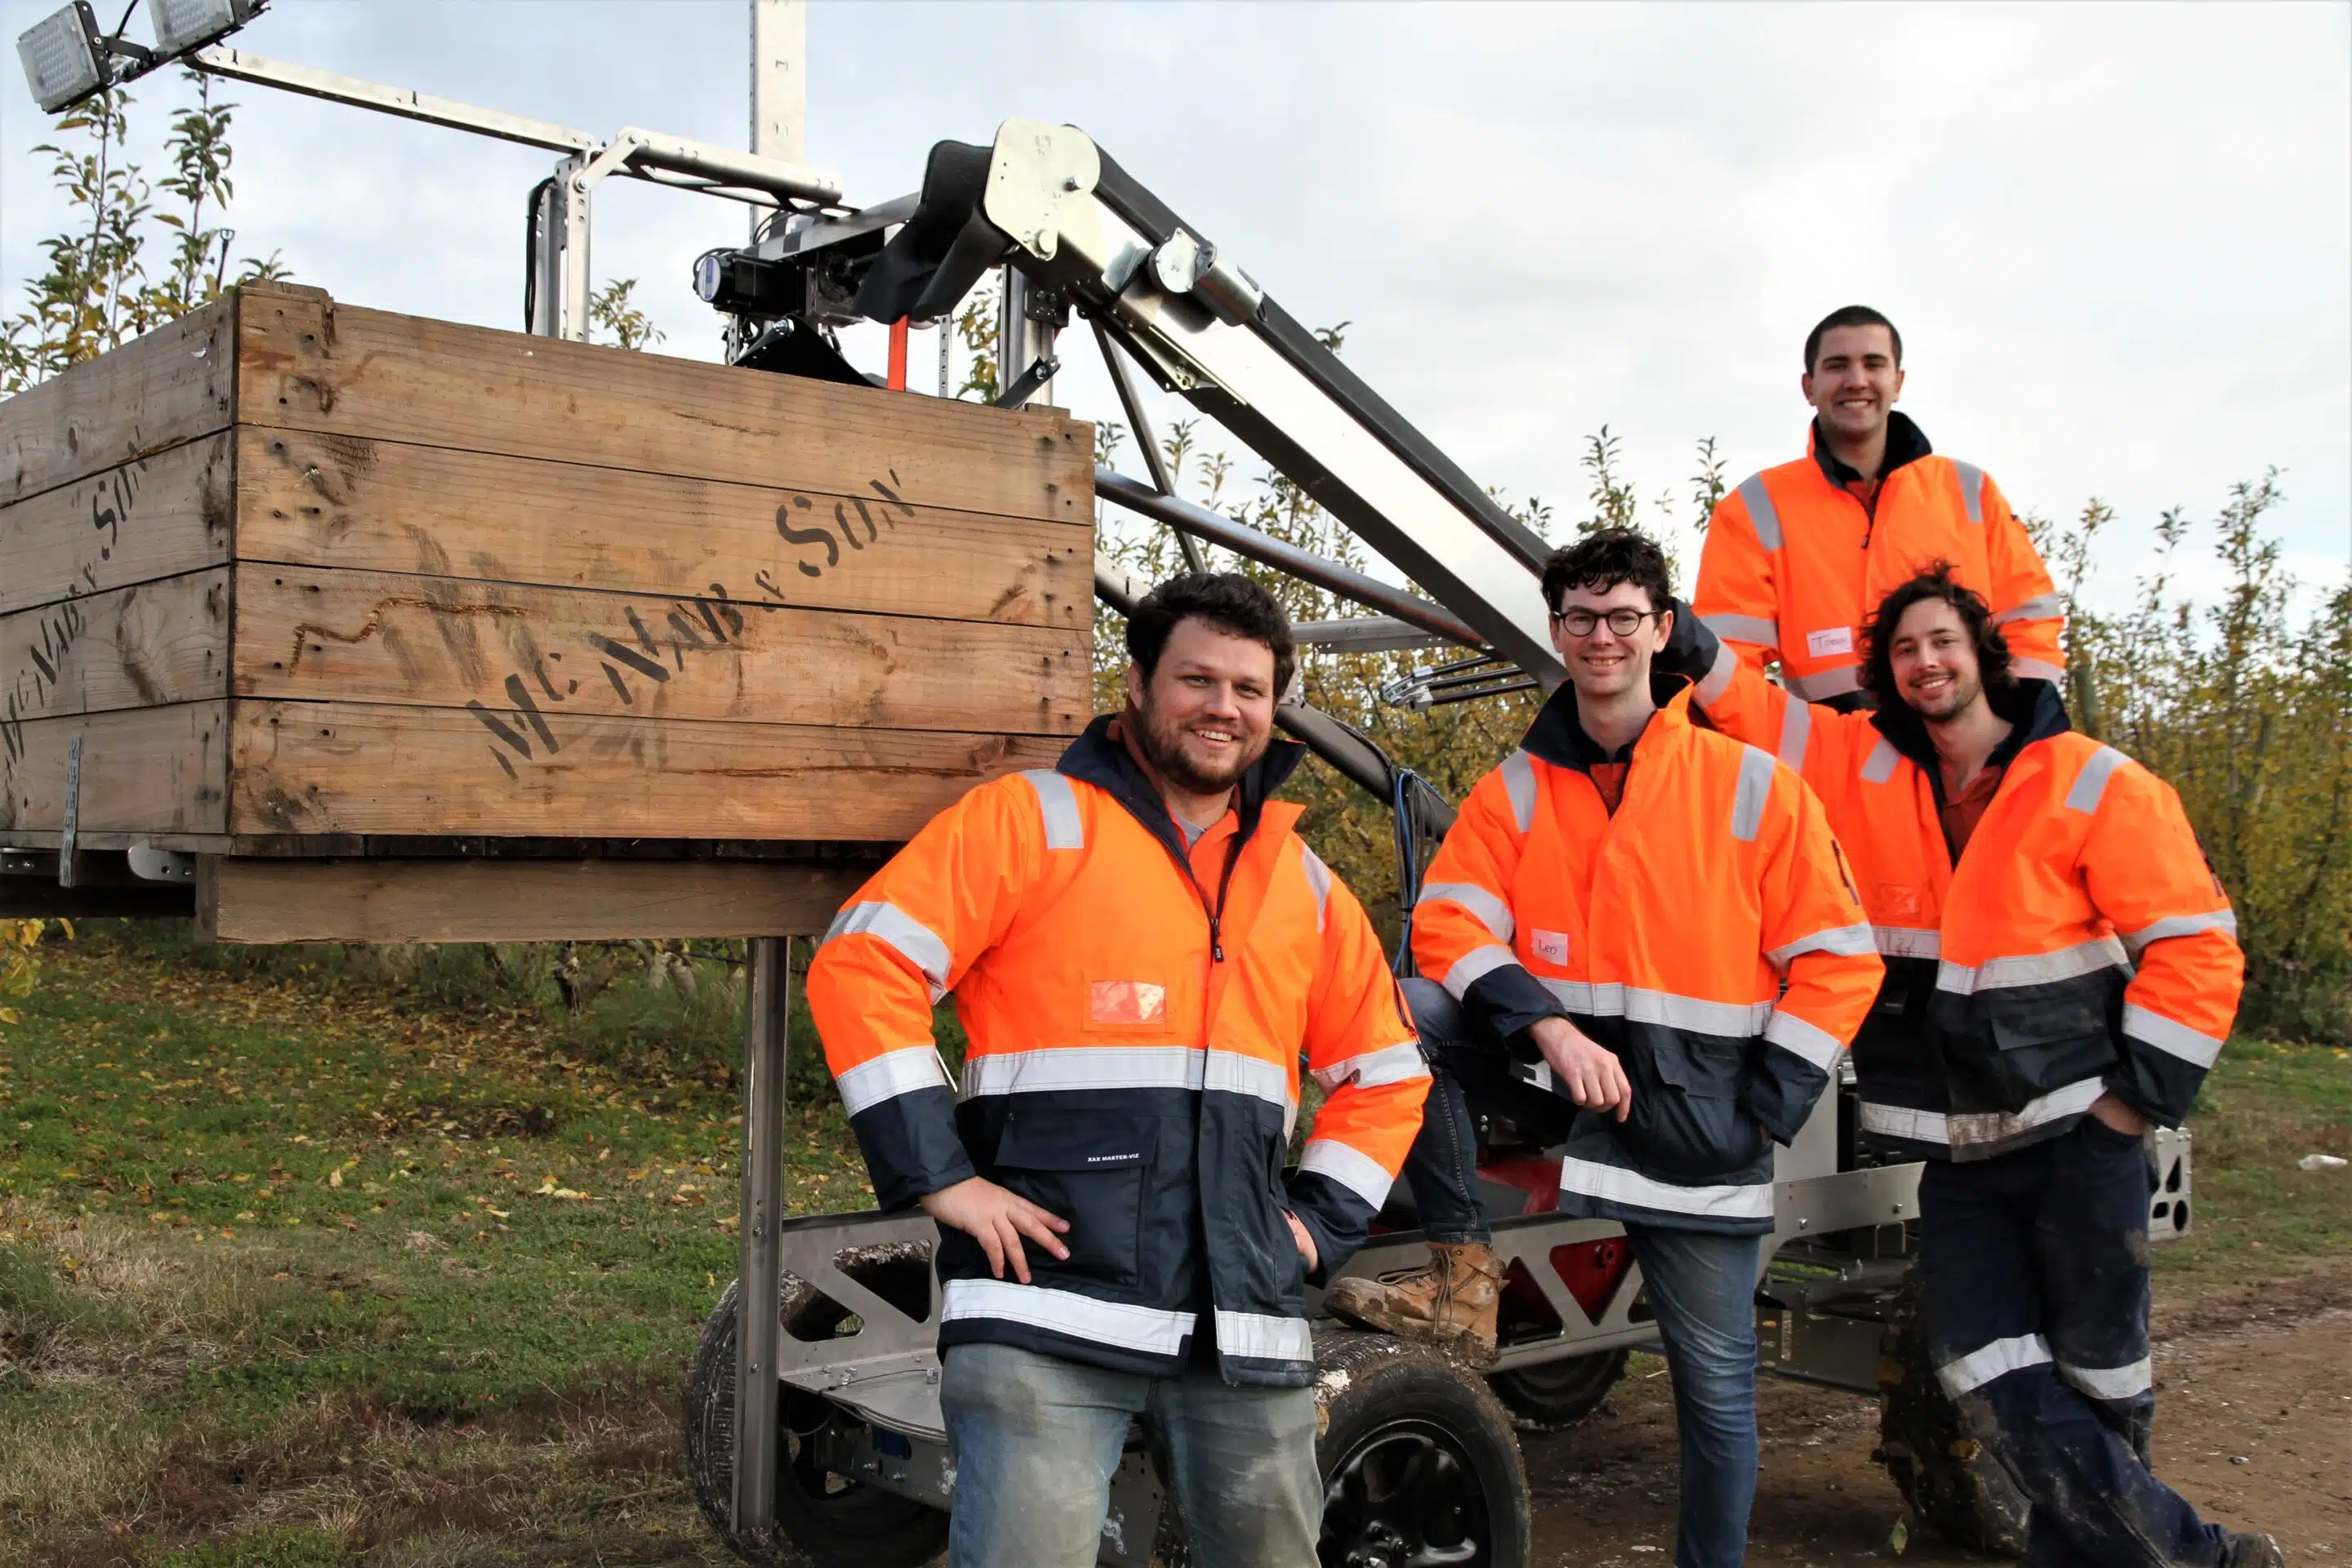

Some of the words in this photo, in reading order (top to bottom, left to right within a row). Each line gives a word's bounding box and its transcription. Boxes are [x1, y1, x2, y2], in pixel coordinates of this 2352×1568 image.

[776, 469, 915, 577] SON
[1539, 939, 1557, 955] Leo
[1102, 1153, 1140, 1161] MASTER-VIZ
